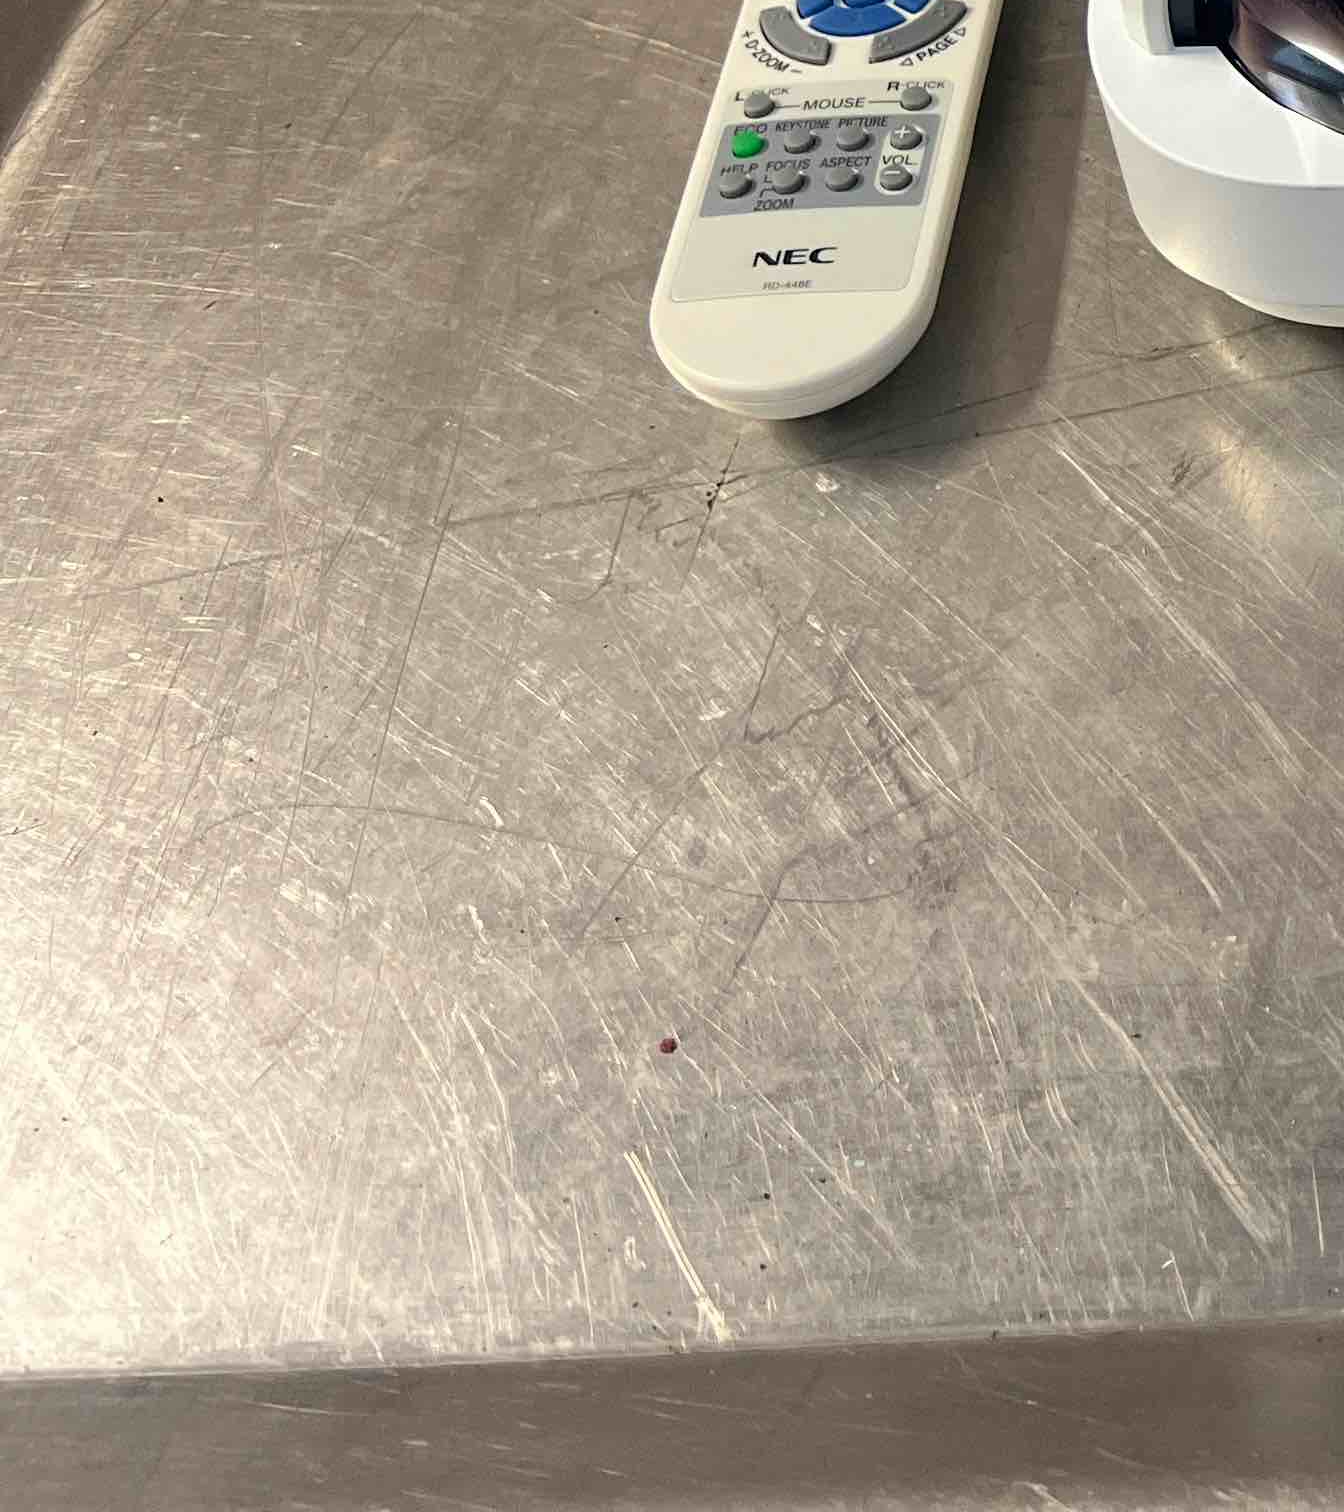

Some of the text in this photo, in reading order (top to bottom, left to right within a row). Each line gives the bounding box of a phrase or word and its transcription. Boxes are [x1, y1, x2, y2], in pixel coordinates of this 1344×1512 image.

[745, 39, 788, 74] D-ZOOM
[918, 37, 958, 62] PAGE
[734, 87, 790, 102] LCICK
[803, 96, 866, 112] MOUSE
[775, 119, 831, 132] KEYSTONE
[766, 158, 812, 172] FOCUS
[819, 155, 872, 169] ASPECT
[753, 197, 796, 212] ZOOM
[751, 246, 838, 268] NEC
